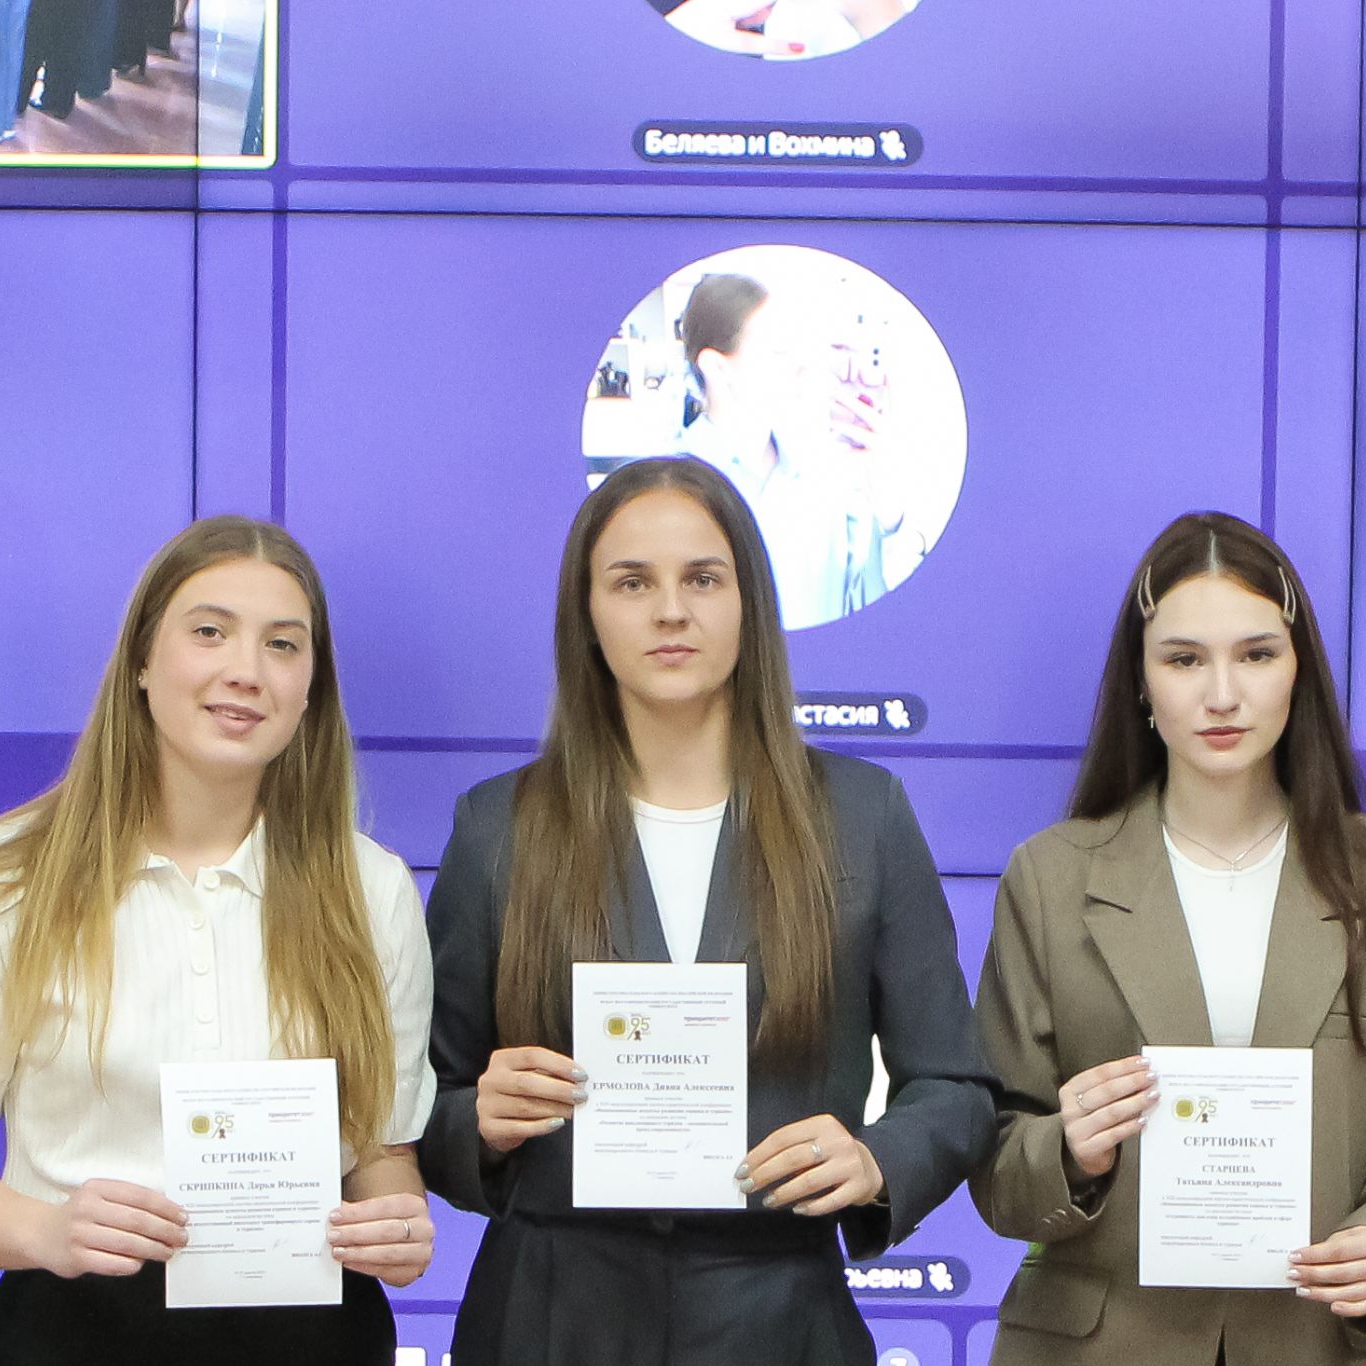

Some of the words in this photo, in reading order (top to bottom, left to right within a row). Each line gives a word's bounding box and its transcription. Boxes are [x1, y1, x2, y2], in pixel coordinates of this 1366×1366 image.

[644, 128, 746, 157] Беляева
[747, 133, 767, 157] и
[767, 130, 876, 159] Вохмина
[616, 1053, 711, 1065] СЕРТИФИКАТ
[1183, 1135, 1276, 1148] СЕРТИФИКАТ
[201, 1151, 297, 1164] СЕРТИФИКАТ
